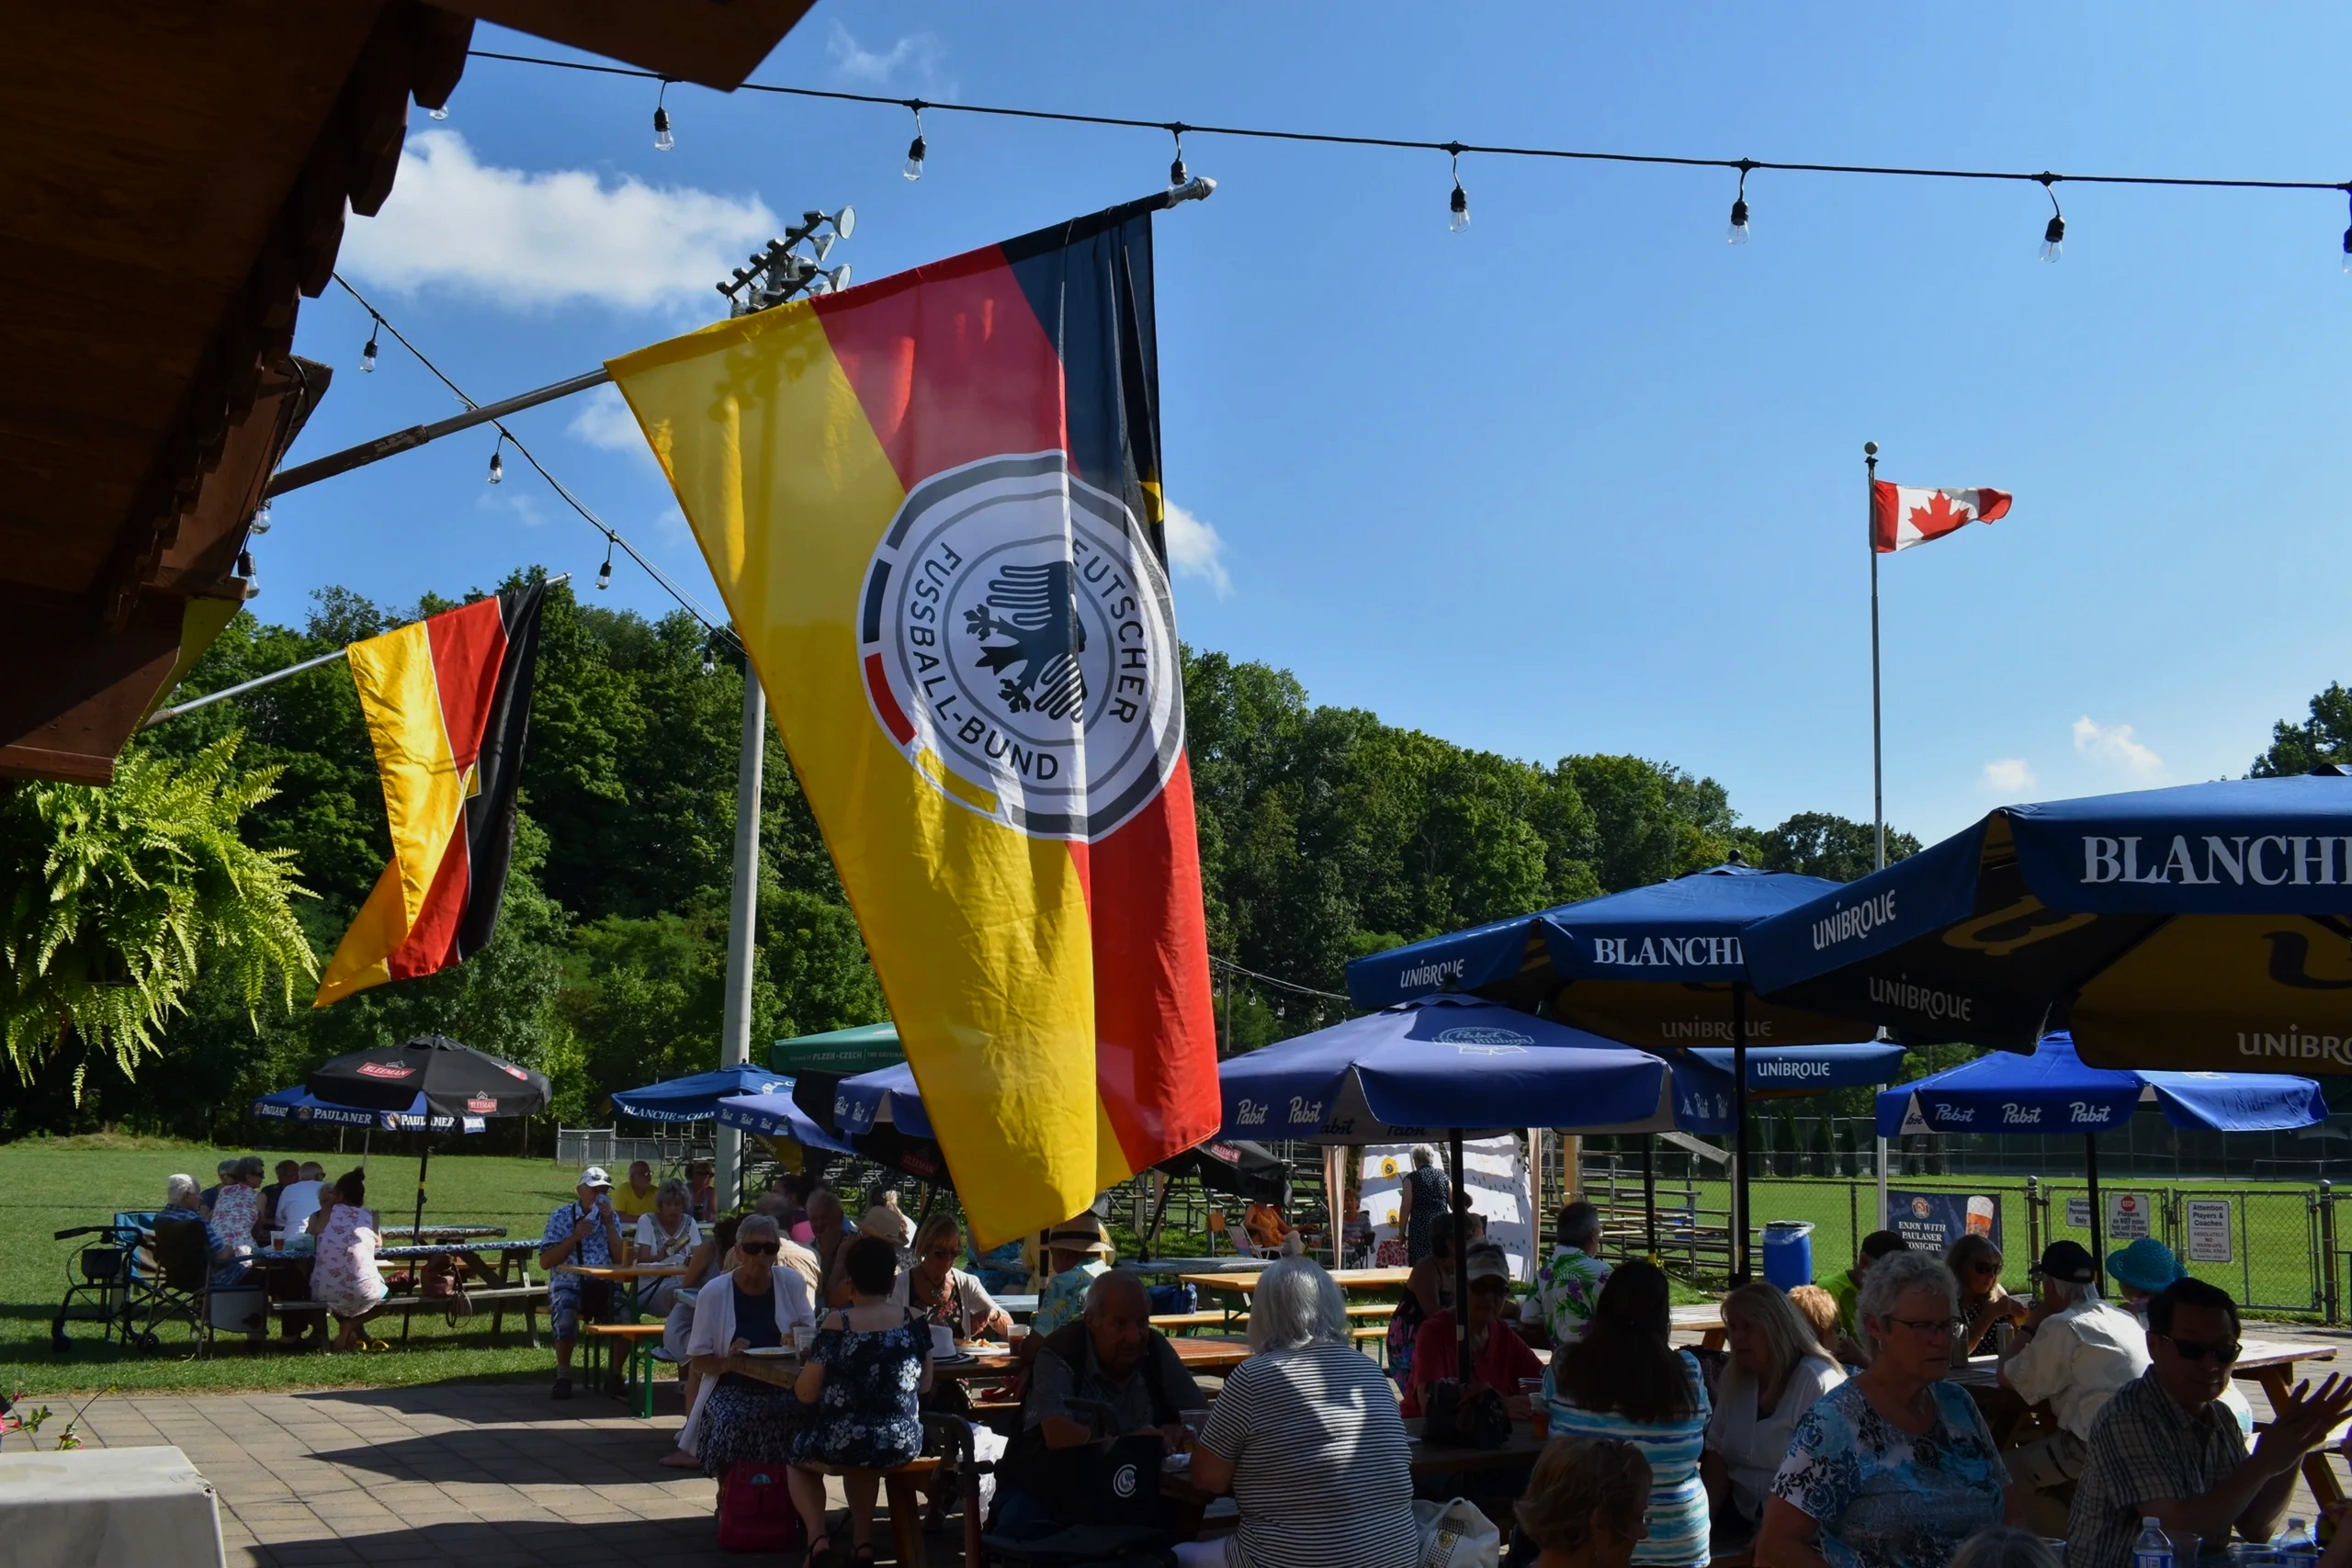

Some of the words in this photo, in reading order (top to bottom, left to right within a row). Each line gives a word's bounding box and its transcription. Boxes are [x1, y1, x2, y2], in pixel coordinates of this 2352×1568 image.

[1072, 537, 1147, 724] EUTSCHER
[910, 542, 1058, 781] FUSSBALL-BUND
[313, 1108, 372, 1124] PAULANER
[623, 1104, 677, 1121] BLANCHE
[1236, 1098, 1268, 1125] Pabst
[1287, 1095, 1323, 1124] Pabst
[1935, 1103, 1975, 1122] Pabst
[2001, 1102, 2041, 1123] Pabst
[2069, 1101, 2111, 1123] Pabst
[2121, 1200, 2135, 1208] STOP
[2192, 1212, 2217, 1220] Players
[2194, 1220, 2223, 1228] Coaches
[1898, 1221, 1921, 1231] ENJOY
[1923, 1223, 1946, 1233] WITH
[1902, 1231, 1942, 1242] PAULANER
